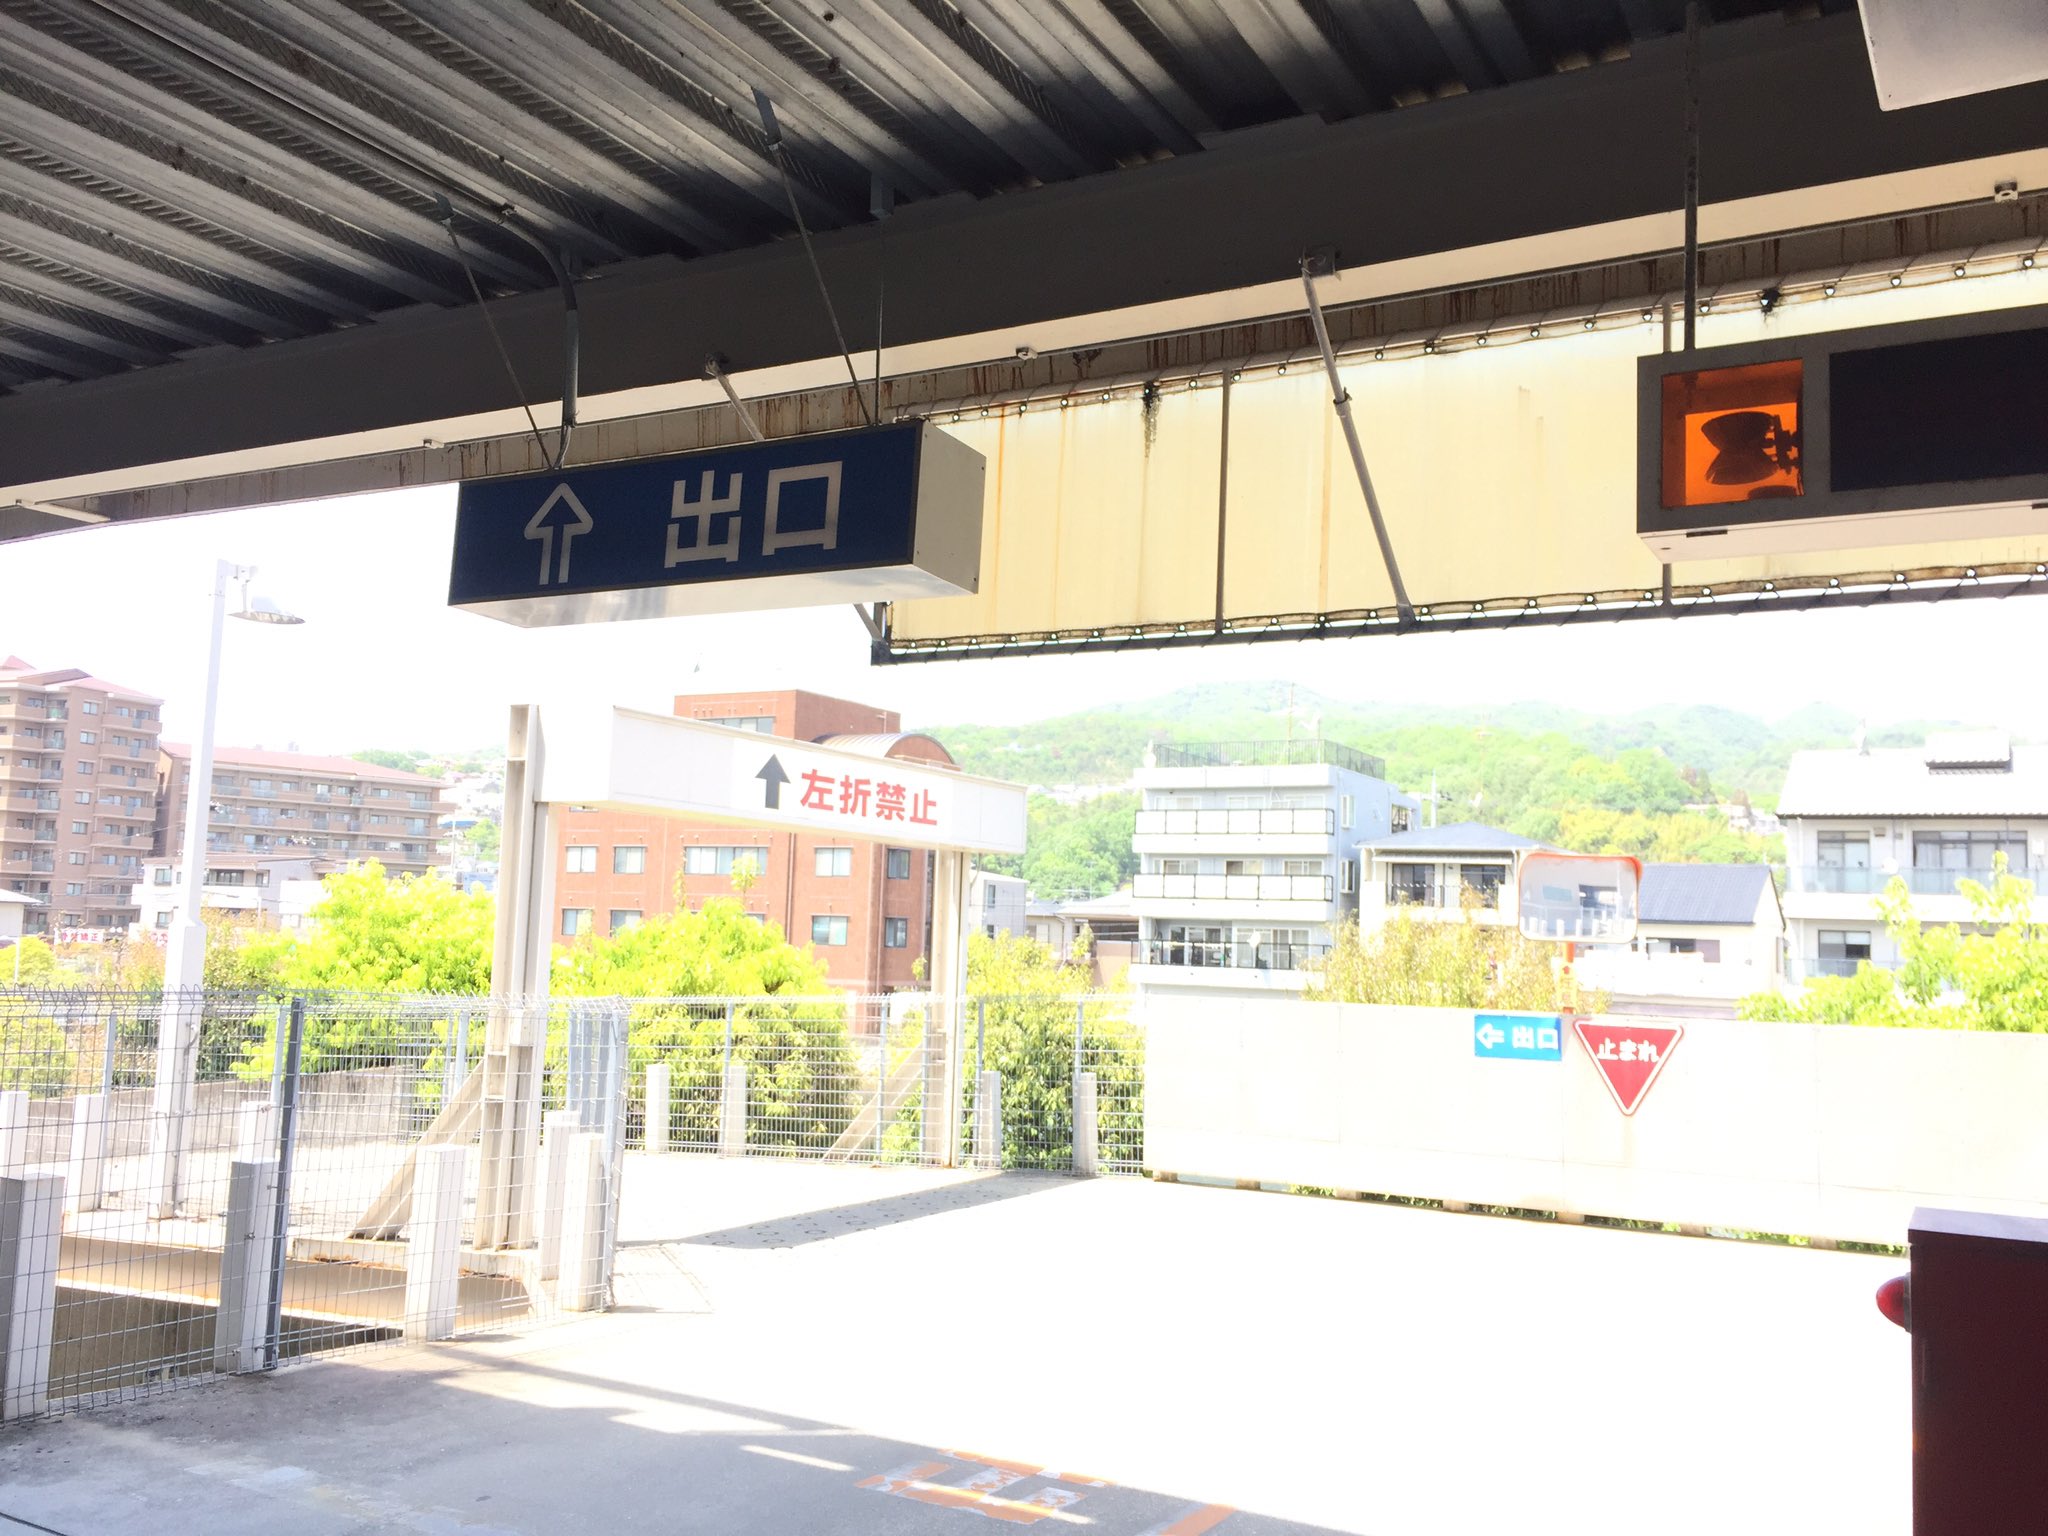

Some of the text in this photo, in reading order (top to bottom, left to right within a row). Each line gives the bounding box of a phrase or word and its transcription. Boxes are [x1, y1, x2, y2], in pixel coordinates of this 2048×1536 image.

[664, 461, 843, 568] 出口
[799, 768, 938, 827] 左折禁止
[1511, 1025, 1559, 1050] 出口
[1597, 1037, 1661, 1063] 止まれ
